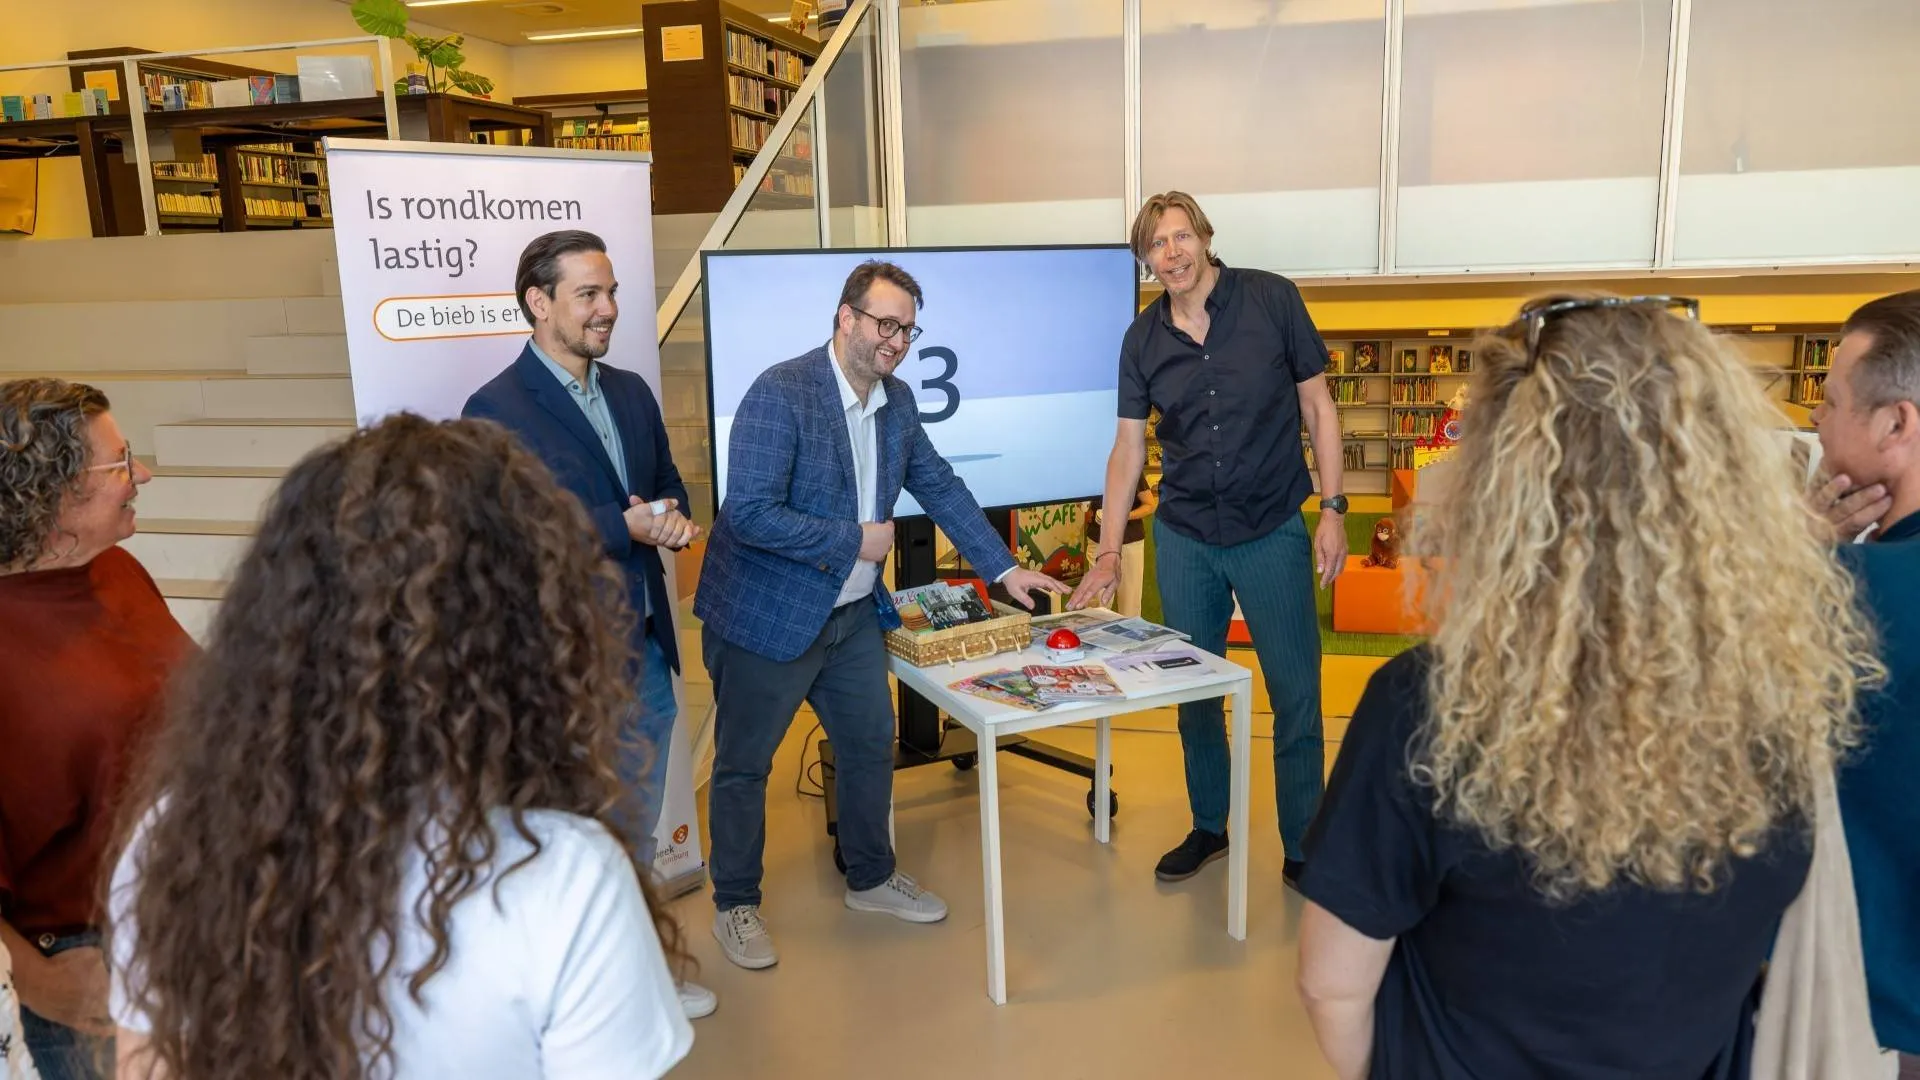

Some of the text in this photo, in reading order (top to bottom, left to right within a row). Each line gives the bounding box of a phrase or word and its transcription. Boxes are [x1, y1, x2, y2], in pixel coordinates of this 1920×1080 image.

[366, 190, 582, 220] Is rondkomen
[369, 238, 478, 278] lastig?
[397, 308, 425, 328] De
[430, 305, 475, 326] bieb
[481, 305, 496, 323] is
[918, 346, 961, 423] 3
